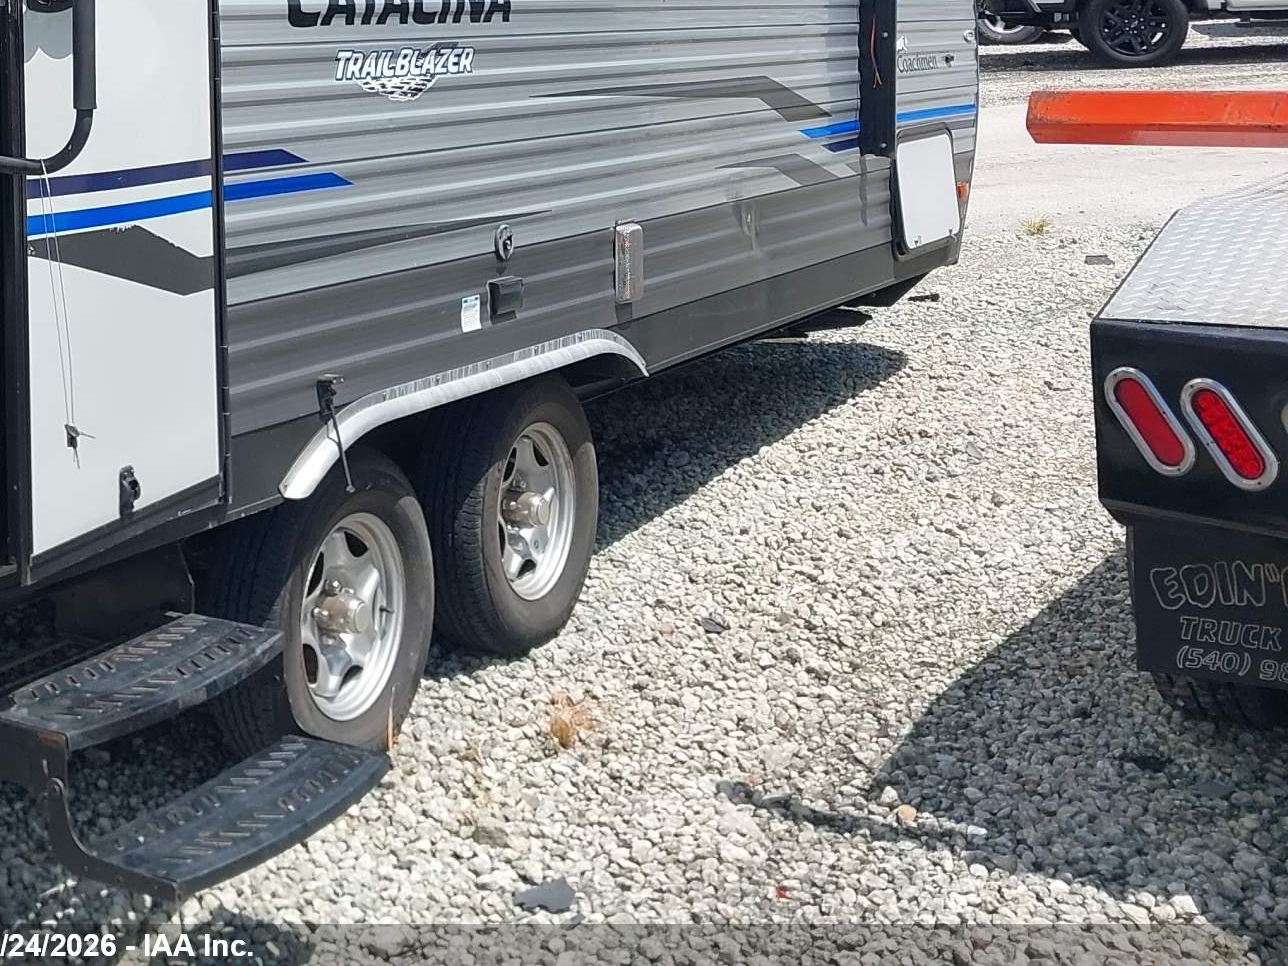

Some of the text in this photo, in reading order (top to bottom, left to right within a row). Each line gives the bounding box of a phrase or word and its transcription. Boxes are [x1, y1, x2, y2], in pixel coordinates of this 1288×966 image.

[335, 46, 475, 81] TRAILBLAZER
[1180, 615, 1282, 651] TRUCK
[1176, 645, 1252, 677] (540)
